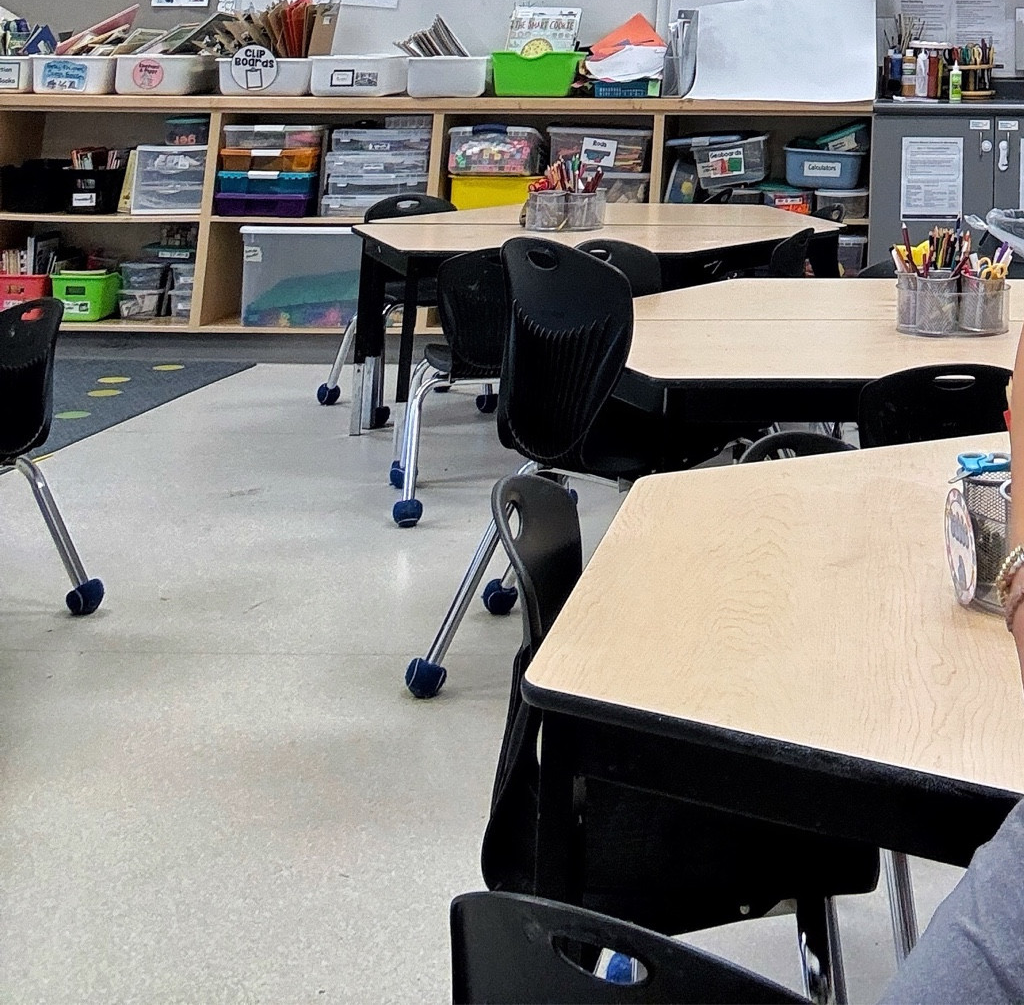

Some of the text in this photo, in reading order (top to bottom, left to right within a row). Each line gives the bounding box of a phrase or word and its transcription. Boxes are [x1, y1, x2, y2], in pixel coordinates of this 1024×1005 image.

[528, 20, 549, 30] SMART
[245, 48, 266, 59] CLIP
[808, 163, 837, 171] Calculators
